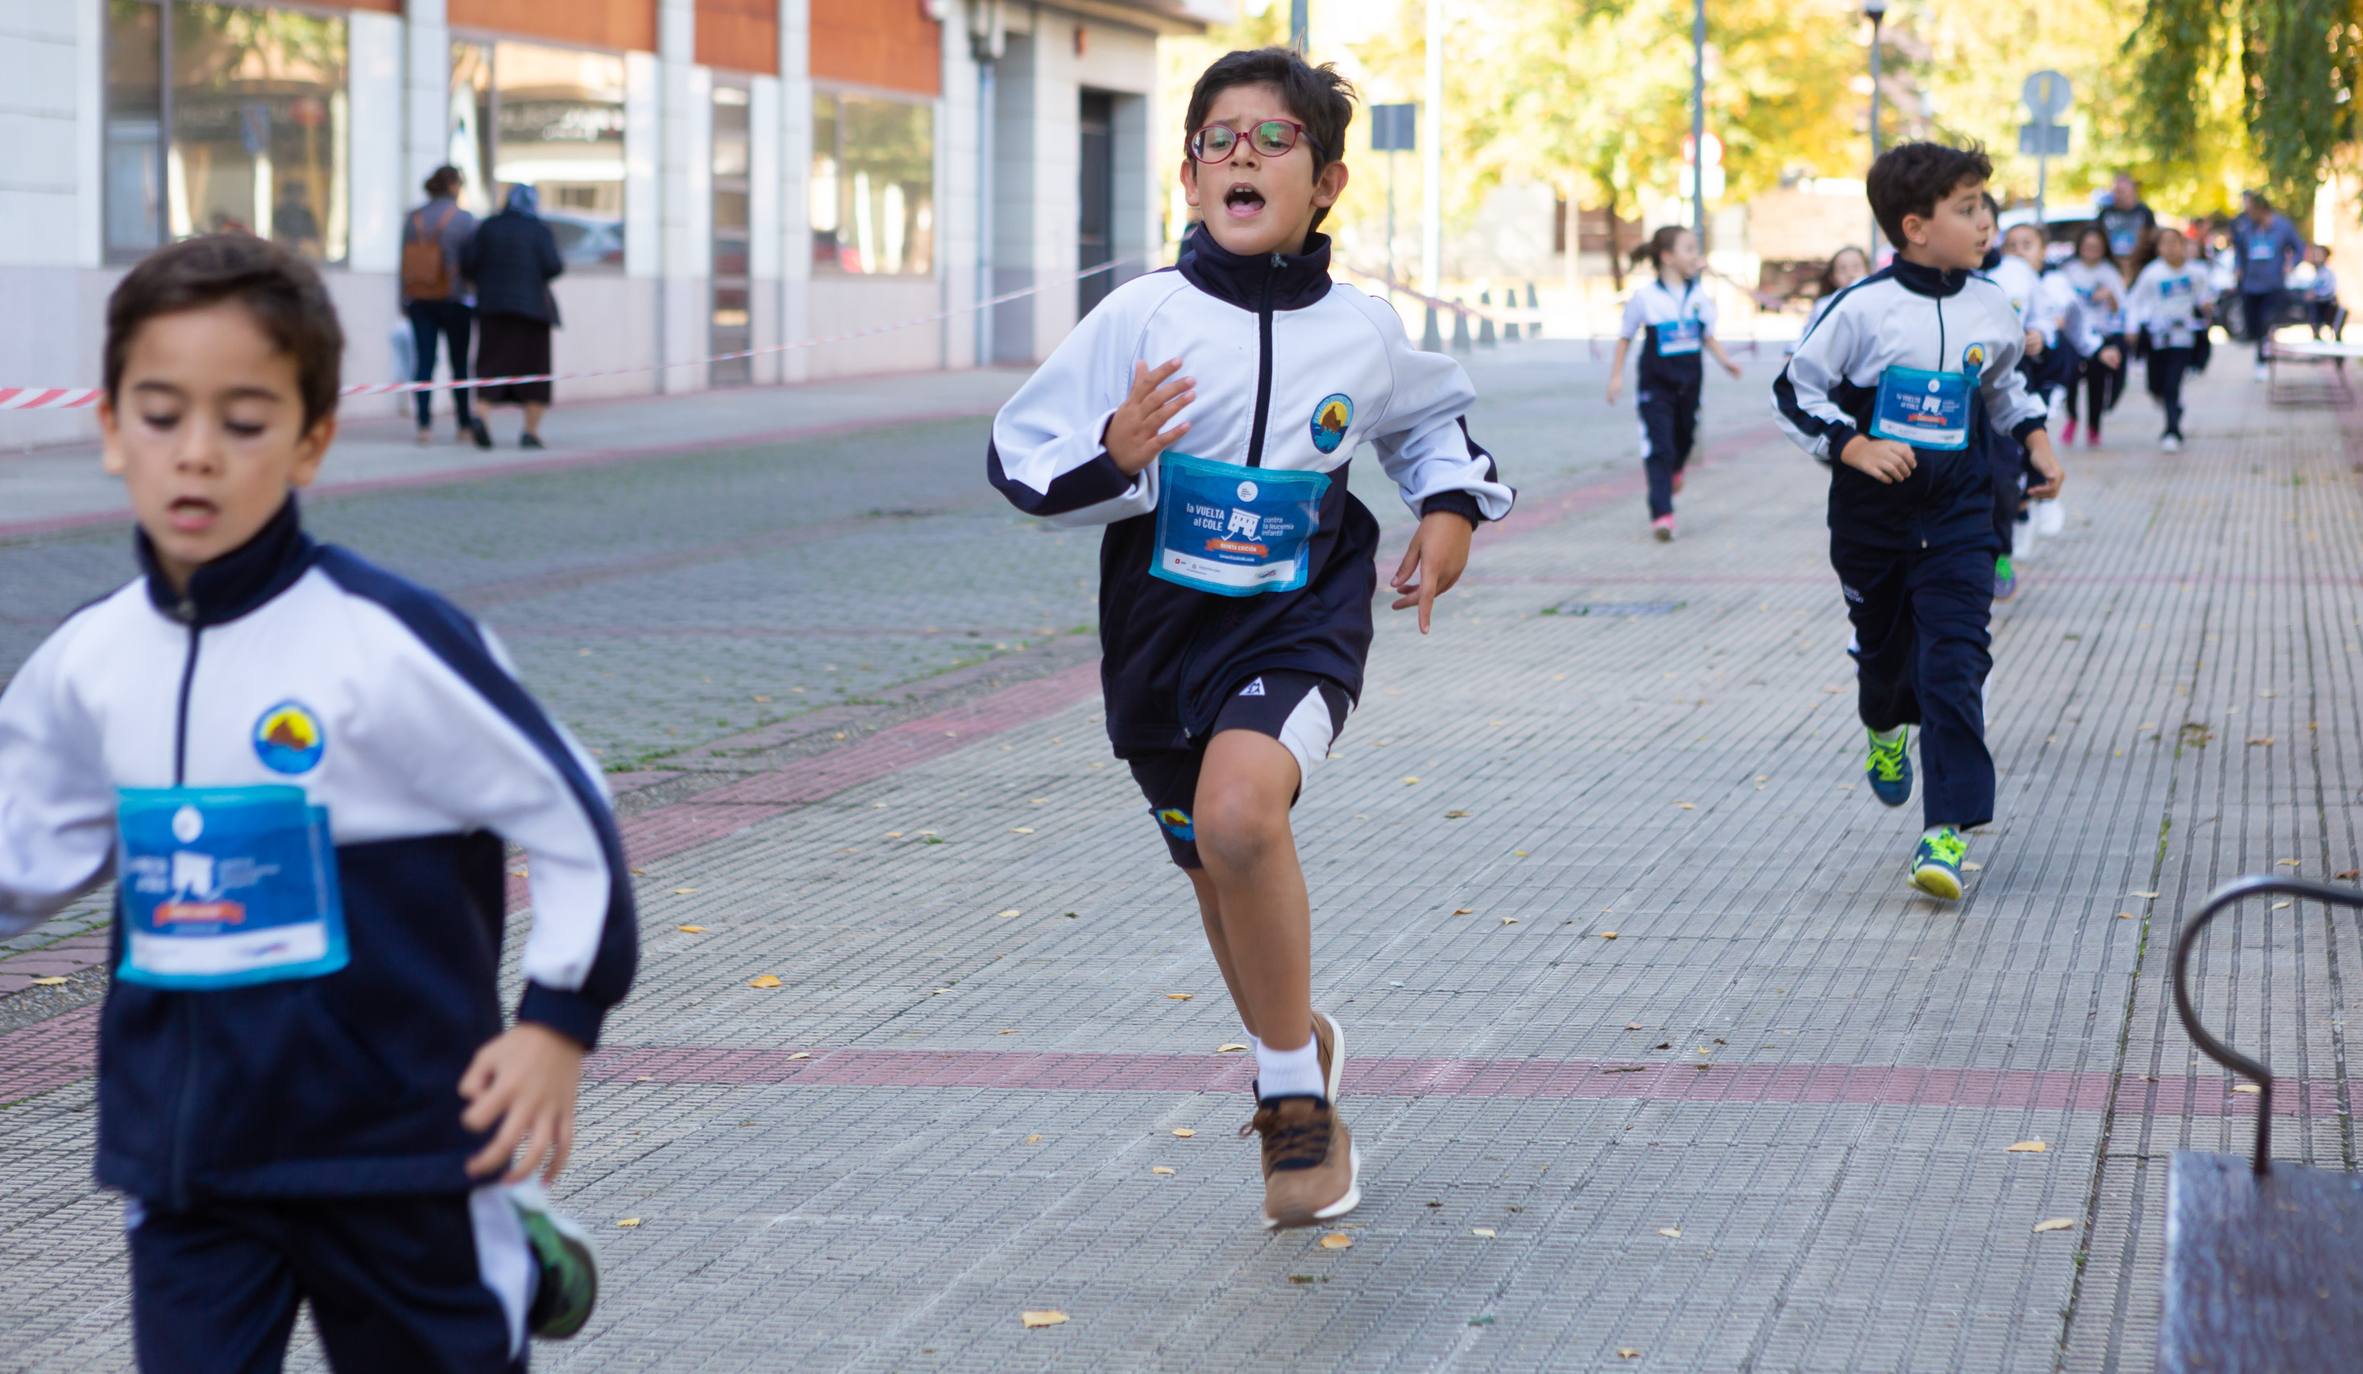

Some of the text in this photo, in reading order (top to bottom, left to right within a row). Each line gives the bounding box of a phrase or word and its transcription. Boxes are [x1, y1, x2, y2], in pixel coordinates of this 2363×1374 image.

[1187, 503, 1225, 520] la VUELTA
[1193, 517, 1223, 531] al COLE
